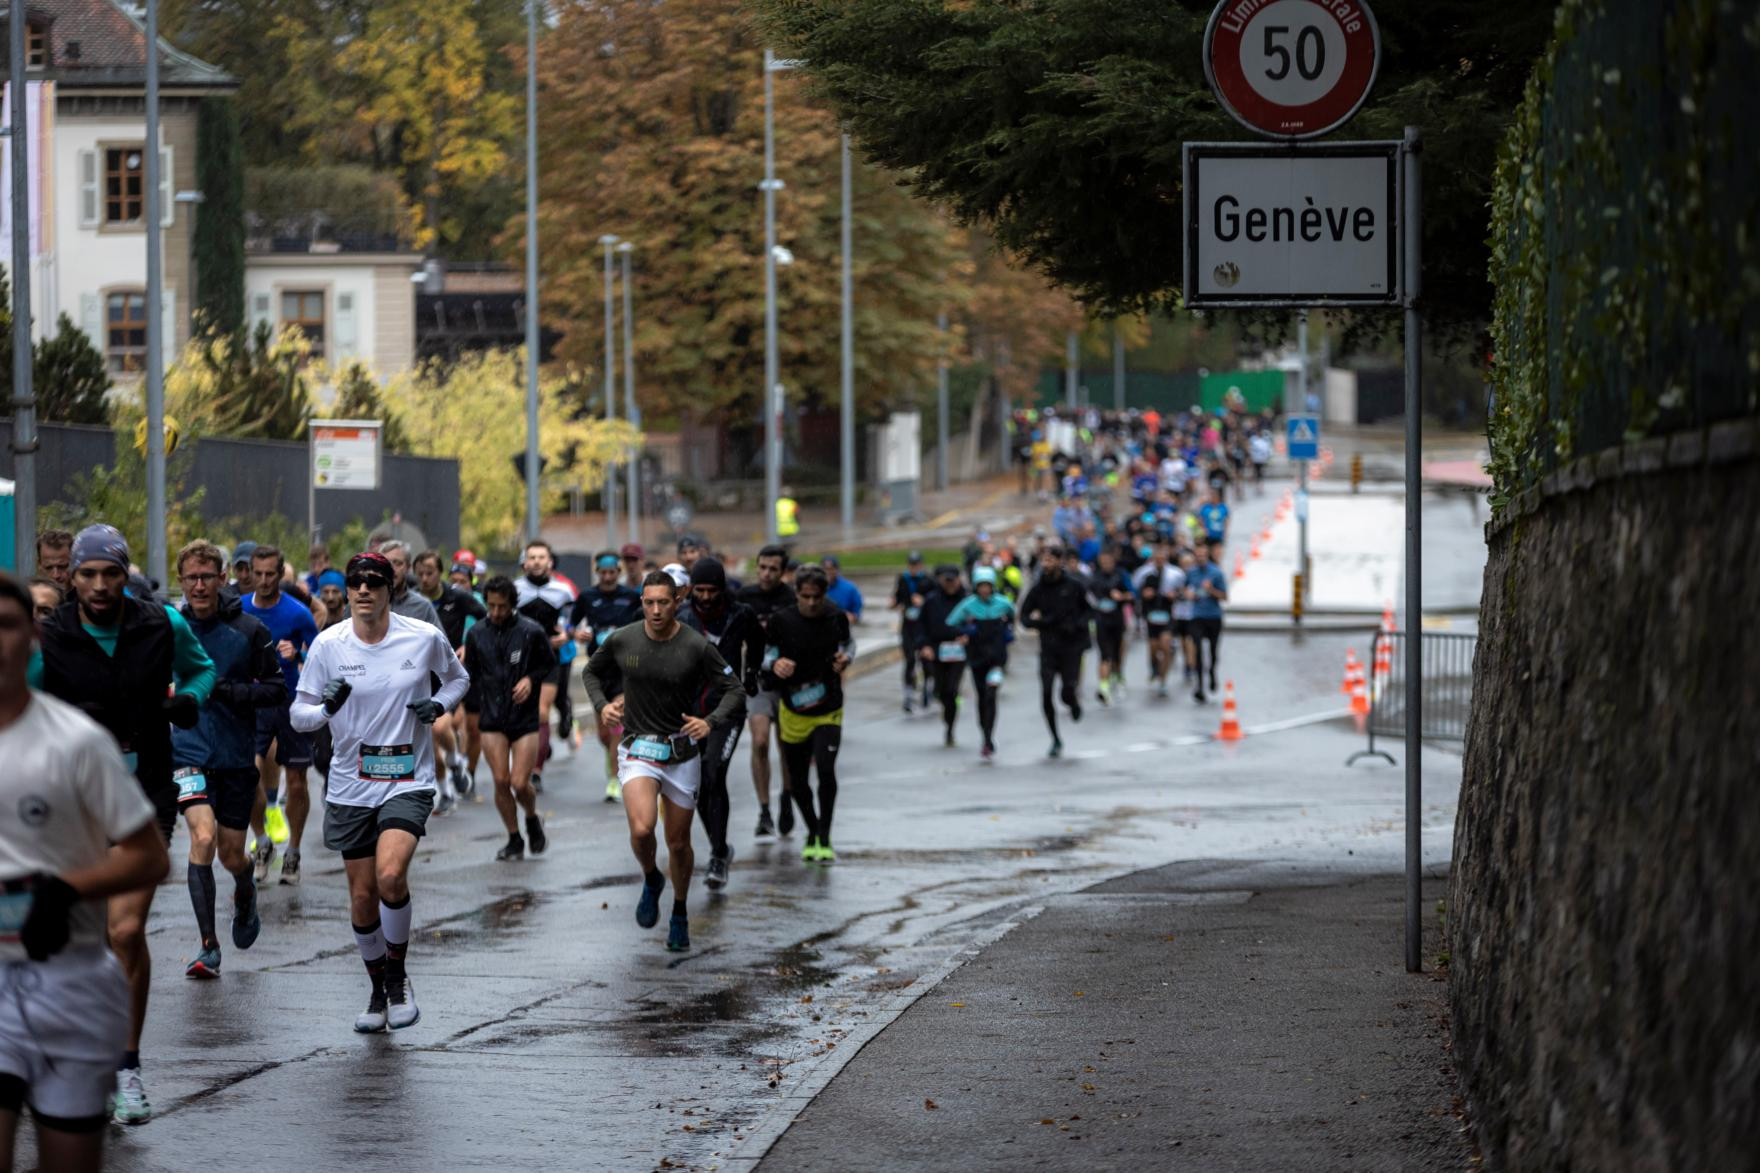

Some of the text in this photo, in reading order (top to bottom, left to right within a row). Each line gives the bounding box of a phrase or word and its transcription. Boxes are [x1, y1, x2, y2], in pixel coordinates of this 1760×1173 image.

[1263, 25, 1326, 81] 50
[1214, 195, 1375, 242] Genève
[374, 763, 405, 773] 2555
